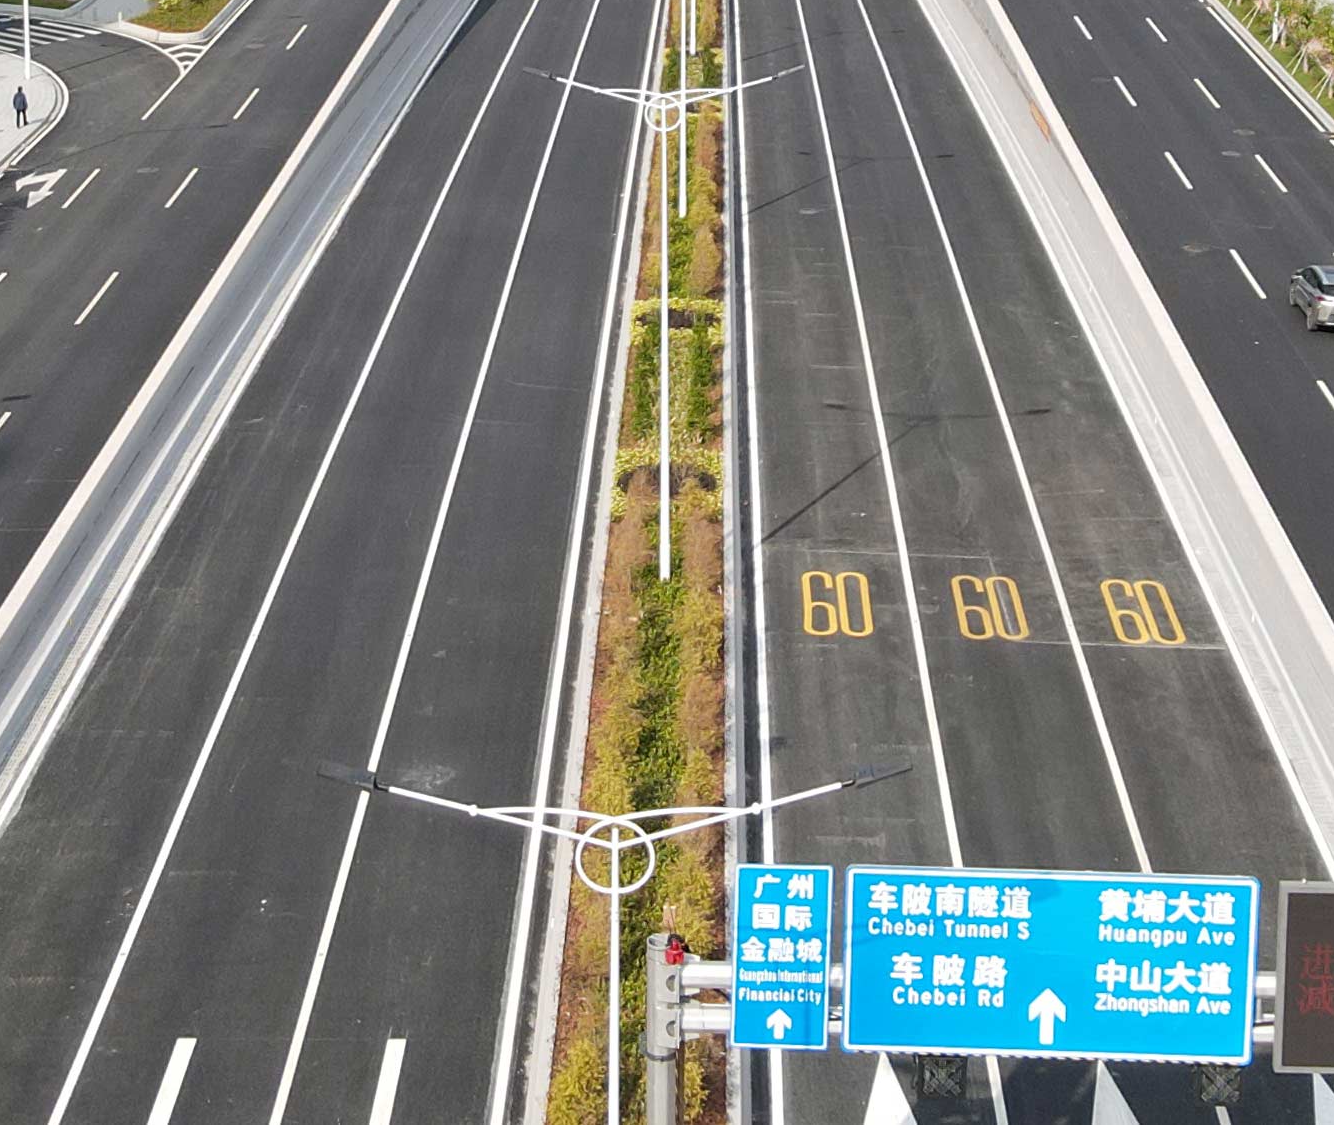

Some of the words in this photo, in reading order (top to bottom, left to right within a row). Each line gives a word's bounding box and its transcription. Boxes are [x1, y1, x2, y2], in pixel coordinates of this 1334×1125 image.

[801, 570, 874, 637] 60
[951, 575, 1030, 641] 60
[1100, 578, 1187, 645] 60
[753, 873, 815, 900] 广州
[868, 881, 1032, 919] 车陂南隧道
[751, 903, 813, 932] 国际
[1098, 888, 1236, 925] 黄埔大道
[868, 916, 935, 937] Chebei
[943, 919, 1009, 939] Tunnel
[1017, 921, 1030, 940] S
[1098, 924, 1187, 948] Huangpu
[1196, 926, 1236, 946] Ave
[740, 935, 823, 964] 金融城
[890, 952, 1008, 988] 车陂路
[1095, 958, 1232, 995] 中山大道
[738, 986, 795, 1002] Financial
[797, 987, 822, 1006] City
[892, 986, 966, 1006] Chebei
[977, 989, 1005, 1008] Rd
[1094, 992, 1190, 1017] Zhongshan
[1196, 996, 1232, 1015] Ave
